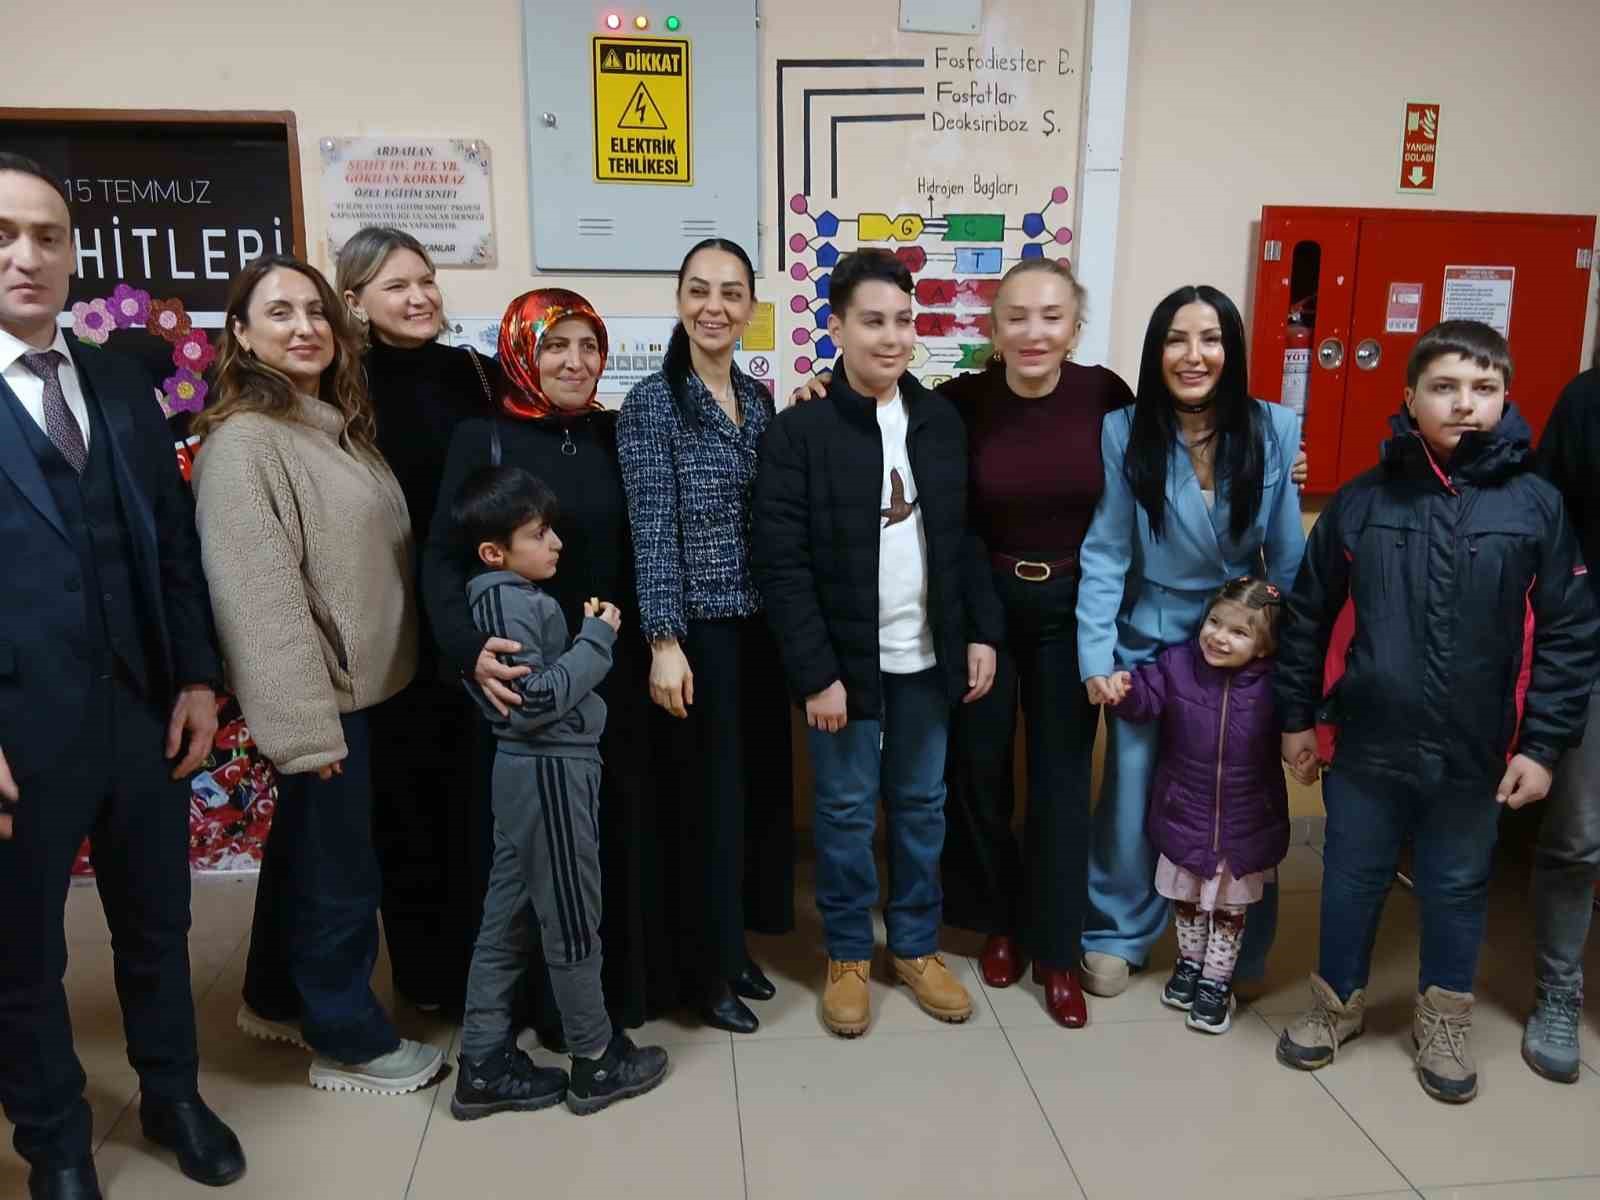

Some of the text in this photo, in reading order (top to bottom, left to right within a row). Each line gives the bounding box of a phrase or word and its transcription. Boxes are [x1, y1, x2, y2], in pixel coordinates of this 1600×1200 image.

[625, 49, 680, 73] DİKKAT
[935, 47, 1047, 72] Fosfodiester
[936, 81, 1017, 107] Fosfatlar
[376, 146, 432, 157] ARDAHAN
[610, 136, 676, 155] ELEKTRİK
[1406, 142, 1435, 153] YANGIN
[608, 156, 679, 175] TEHLİKESİ
[1404, 153, 1434, 162] DOLABI
[402, 174, 465, 185] KORKMAZ
[917, 176, 964, 198] Hidrojen
[65, 179, 212, 204] 15 TEMMUZ
[902, 218, 914, 236] G
[964, 220, 978, 237] C
[971, 252, 984, 269] T
